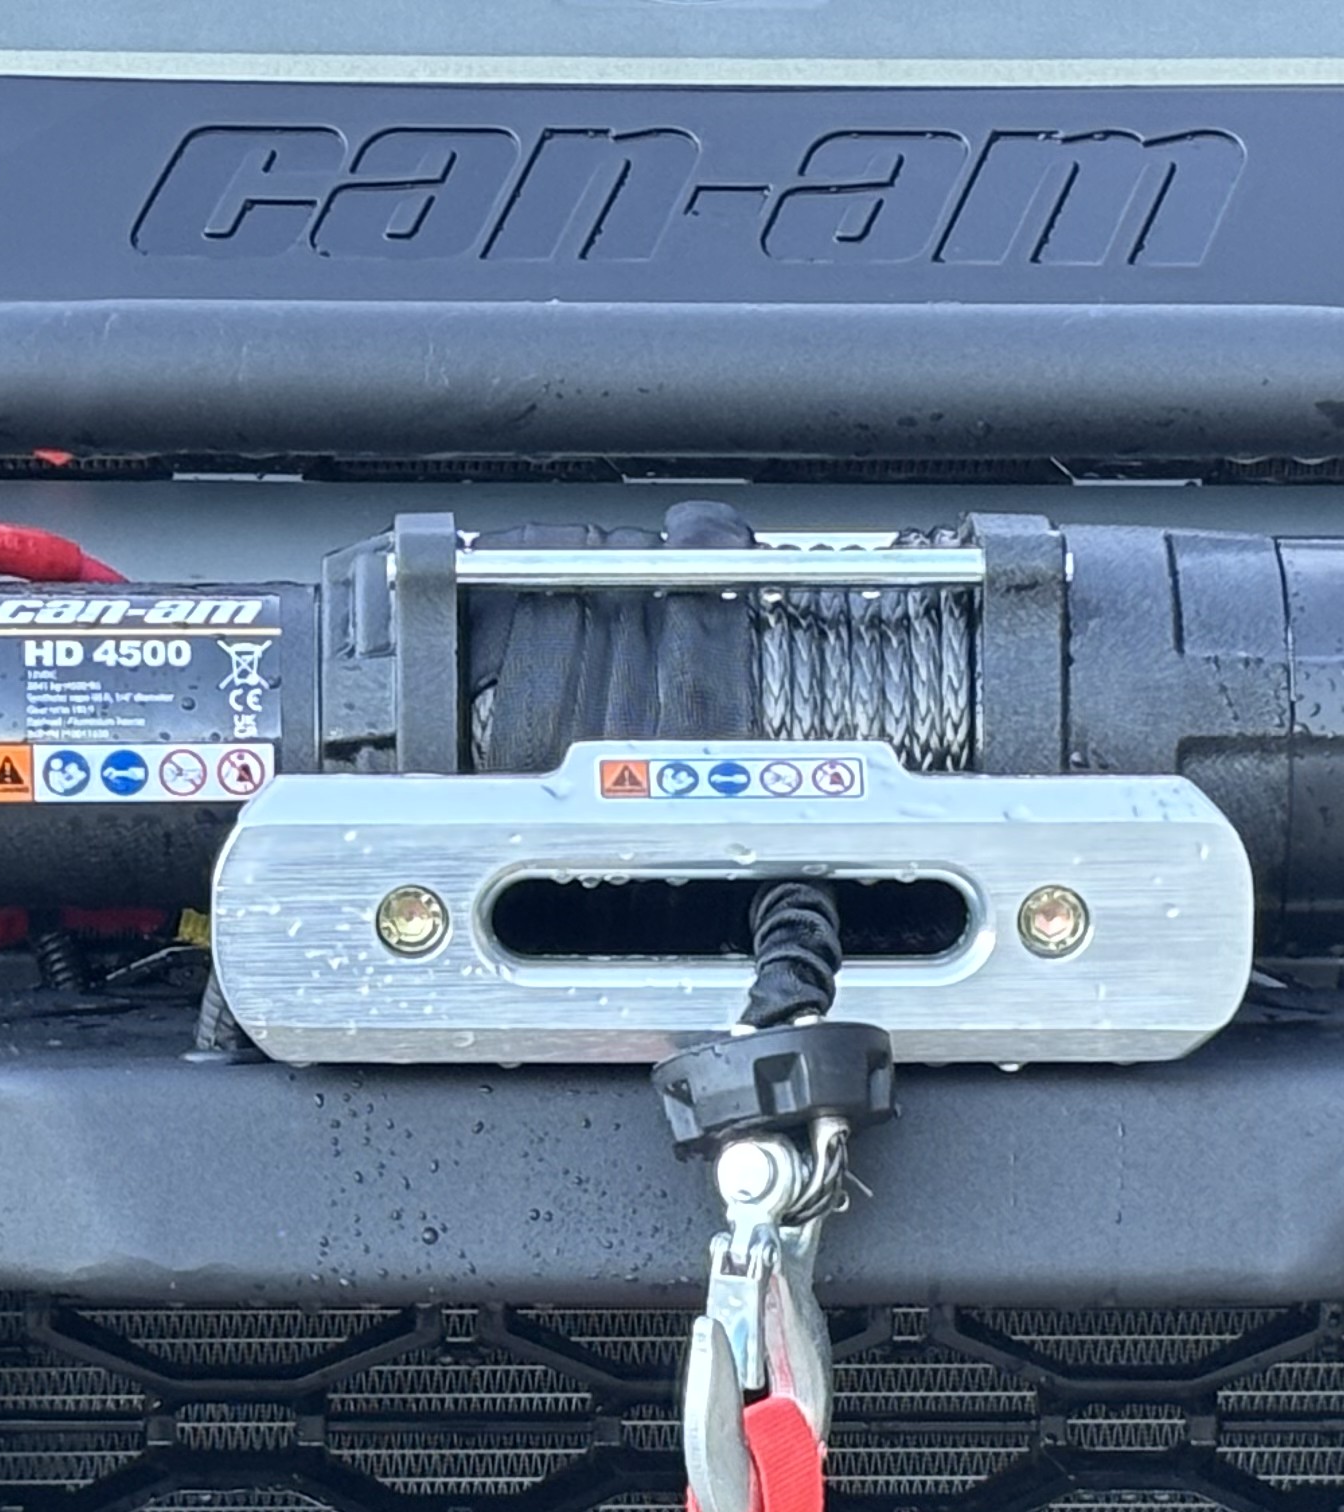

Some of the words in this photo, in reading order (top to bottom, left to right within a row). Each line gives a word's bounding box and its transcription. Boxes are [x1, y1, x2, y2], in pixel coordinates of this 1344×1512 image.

[130, 124, 1248, 267] can-am
[24, 639, 84, 667] HD
[92, 639, 192, 667] 4500
[229, 688, 263, 712] CE
